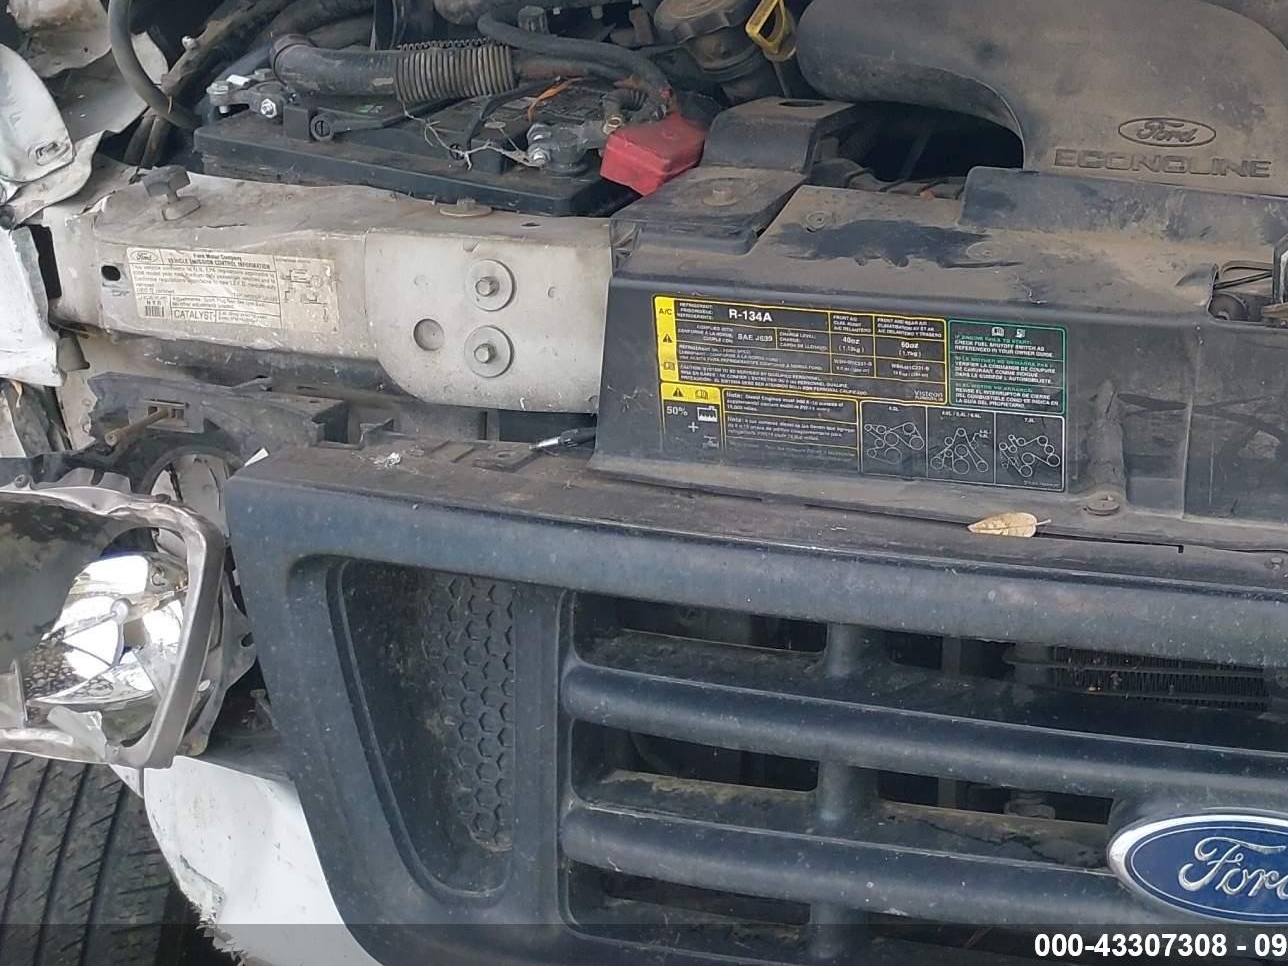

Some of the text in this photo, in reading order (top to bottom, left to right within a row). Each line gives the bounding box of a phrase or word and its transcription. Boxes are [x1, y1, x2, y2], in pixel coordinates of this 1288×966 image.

[1135, 119, 1199, 144] Ford
[1053, 148, 1272, 178] ECONOLINE
[174, 310, 214, 320] CATALYST
[658, 308, 672, 316] A/C
[728, 308, 772, 322] R-134A
[842, 336, 860, 344] 40oz
[914, 389, 943, 398] Visteon
[666, 405, 688, 416] 50%
